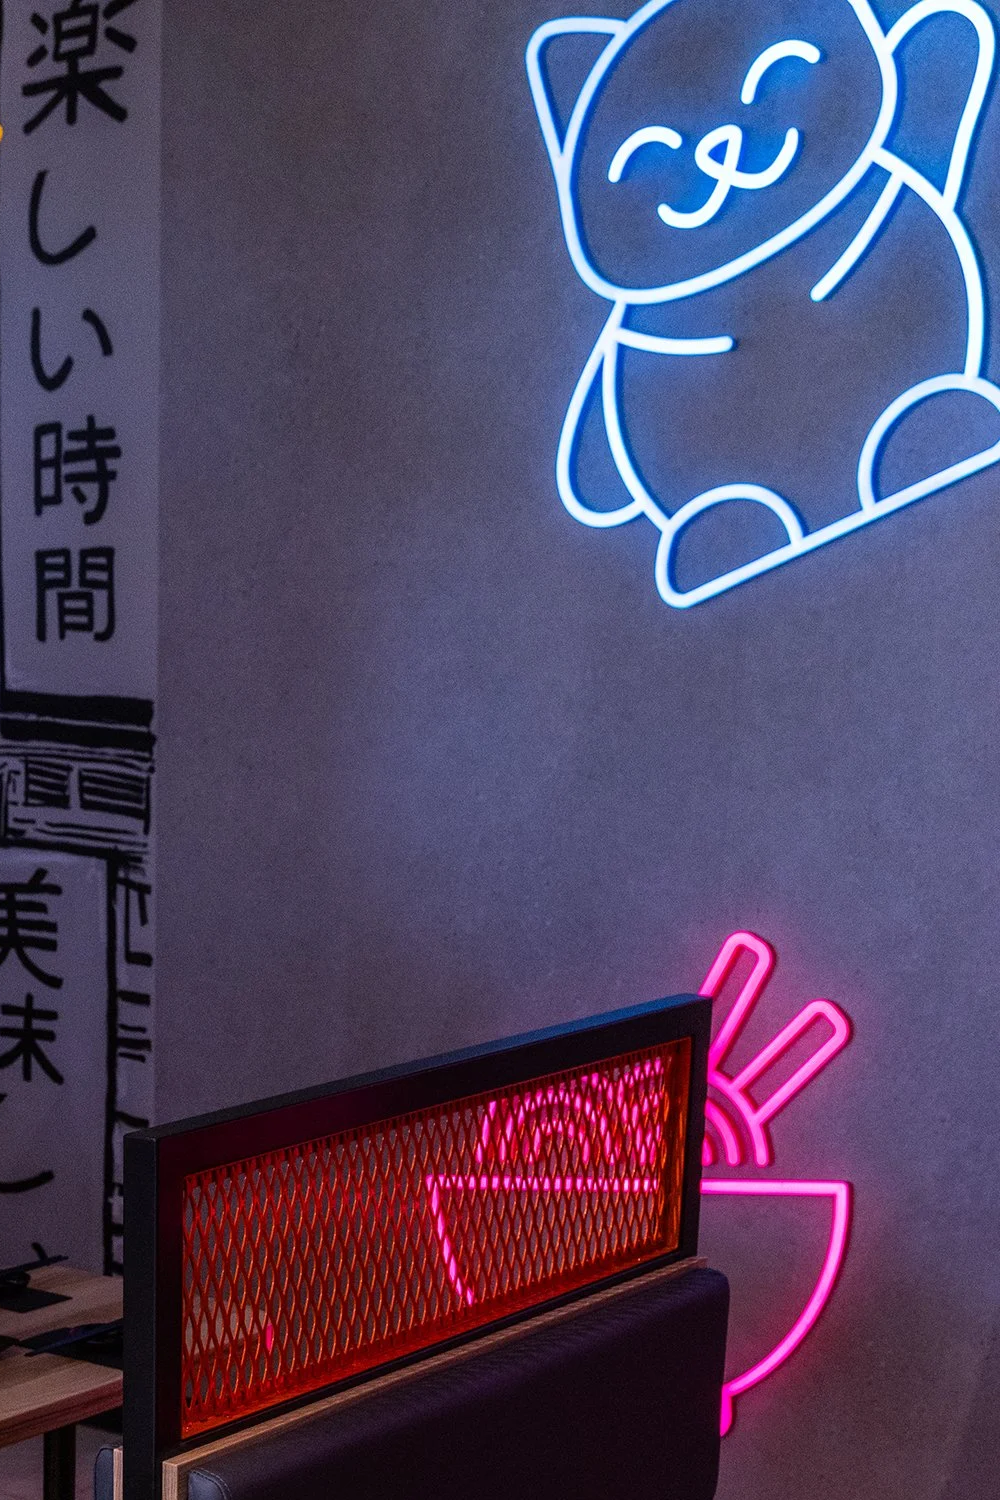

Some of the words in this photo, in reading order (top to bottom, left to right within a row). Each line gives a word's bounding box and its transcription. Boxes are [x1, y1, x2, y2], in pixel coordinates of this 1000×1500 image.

[21, 0, 137, 642] 楽しい時間
